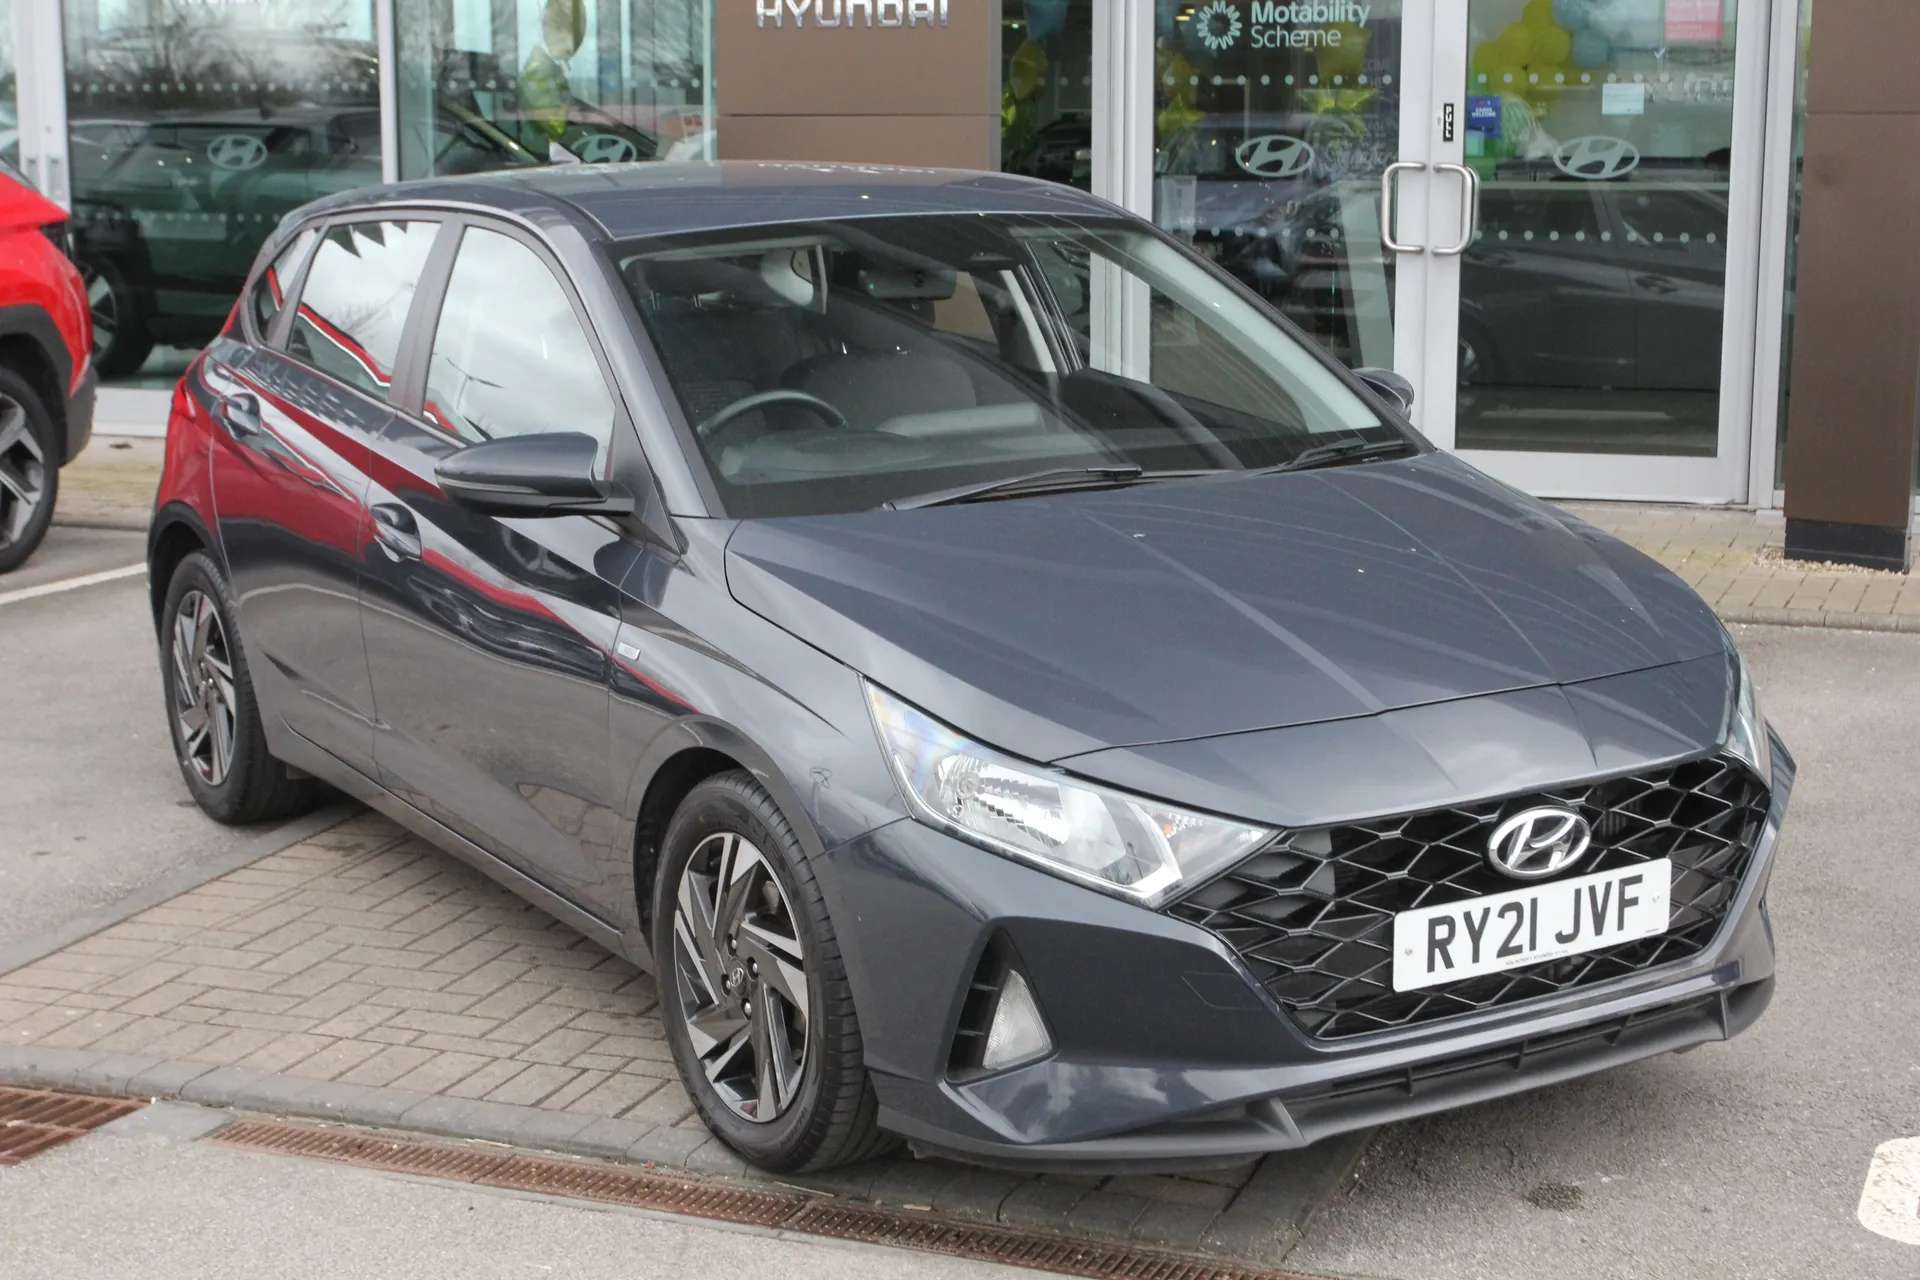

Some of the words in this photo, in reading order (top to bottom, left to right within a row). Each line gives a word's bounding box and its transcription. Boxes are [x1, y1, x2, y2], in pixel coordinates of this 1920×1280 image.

[756, 0, 949, 27] HYUNDAI
[1251, 0, 1371, 28] Motability
[1251, 25, 1342, 48] Scheme
[1445, 105, 1453, 139] PULL
[1426, 897, 1538, 973] RY21
[1555, 874, 1644, 945] JVF
